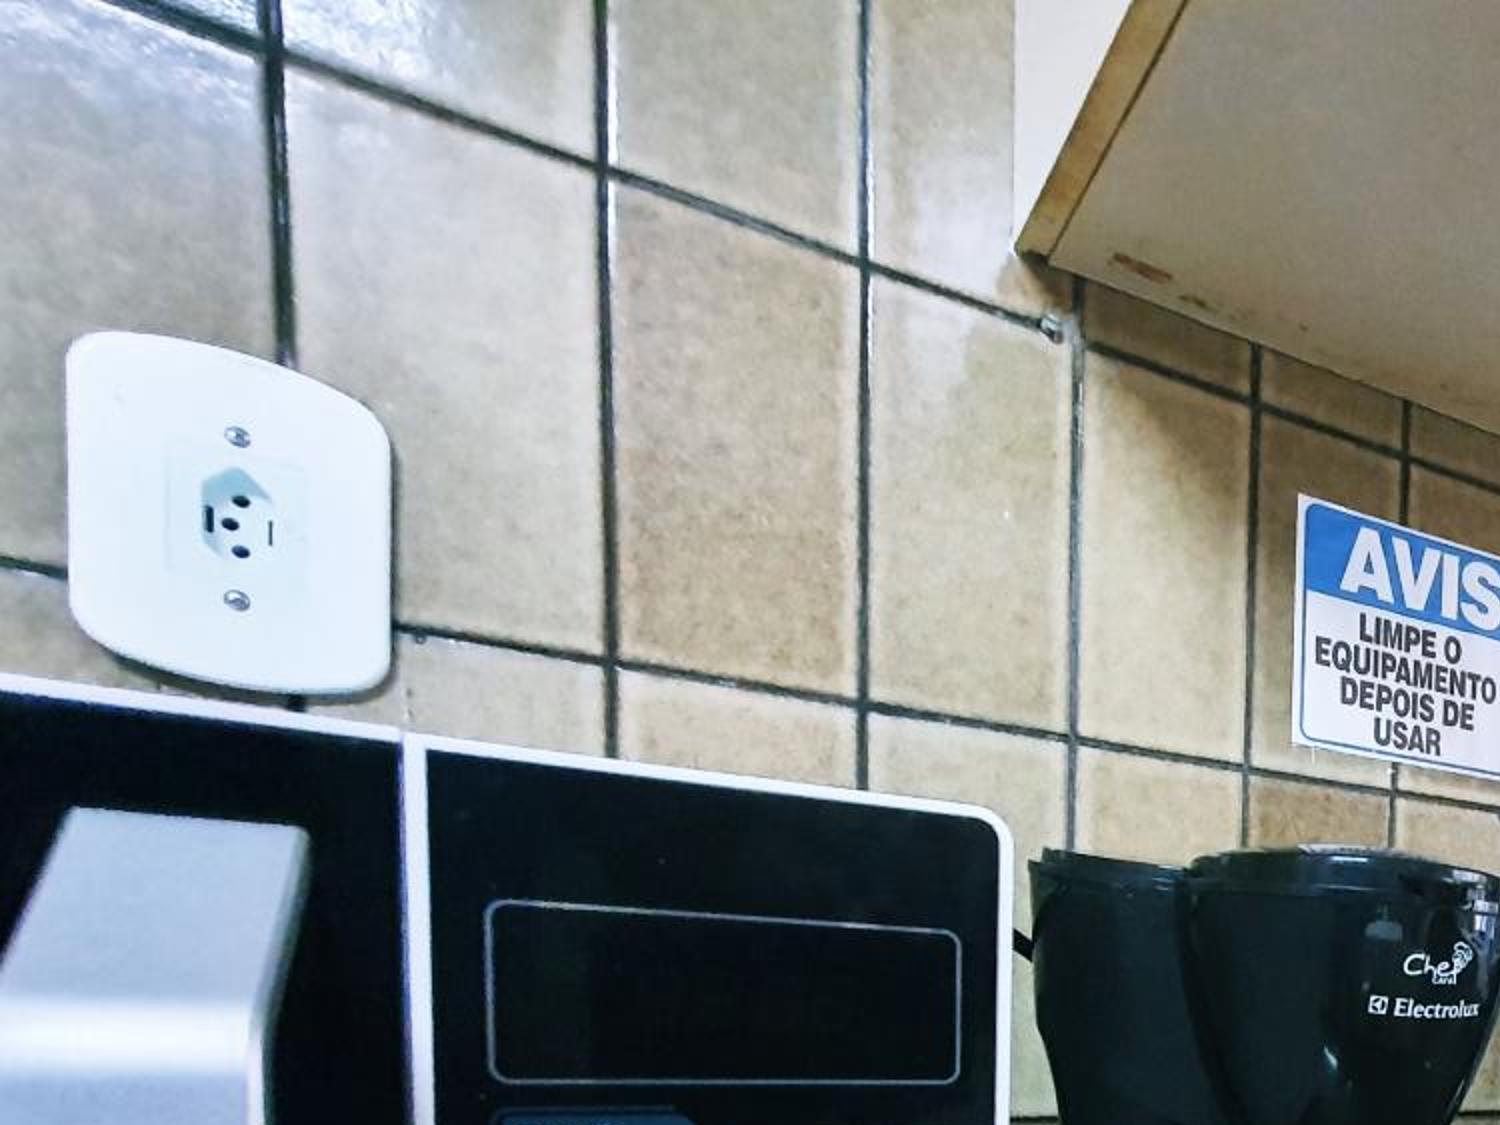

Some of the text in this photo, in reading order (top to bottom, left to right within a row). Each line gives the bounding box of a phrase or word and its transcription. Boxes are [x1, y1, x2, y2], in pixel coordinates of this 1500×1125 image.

[1359, 613, 1462, 664] LIMPE O
[1315, 636, 1496, 704] EQUIPAMENTO
[1340, 676, 1475, 731] DEPOIS DE
[1374, 717, 1441, 756] USAR
[1394, 997, 1480, 1019] Electrolux
